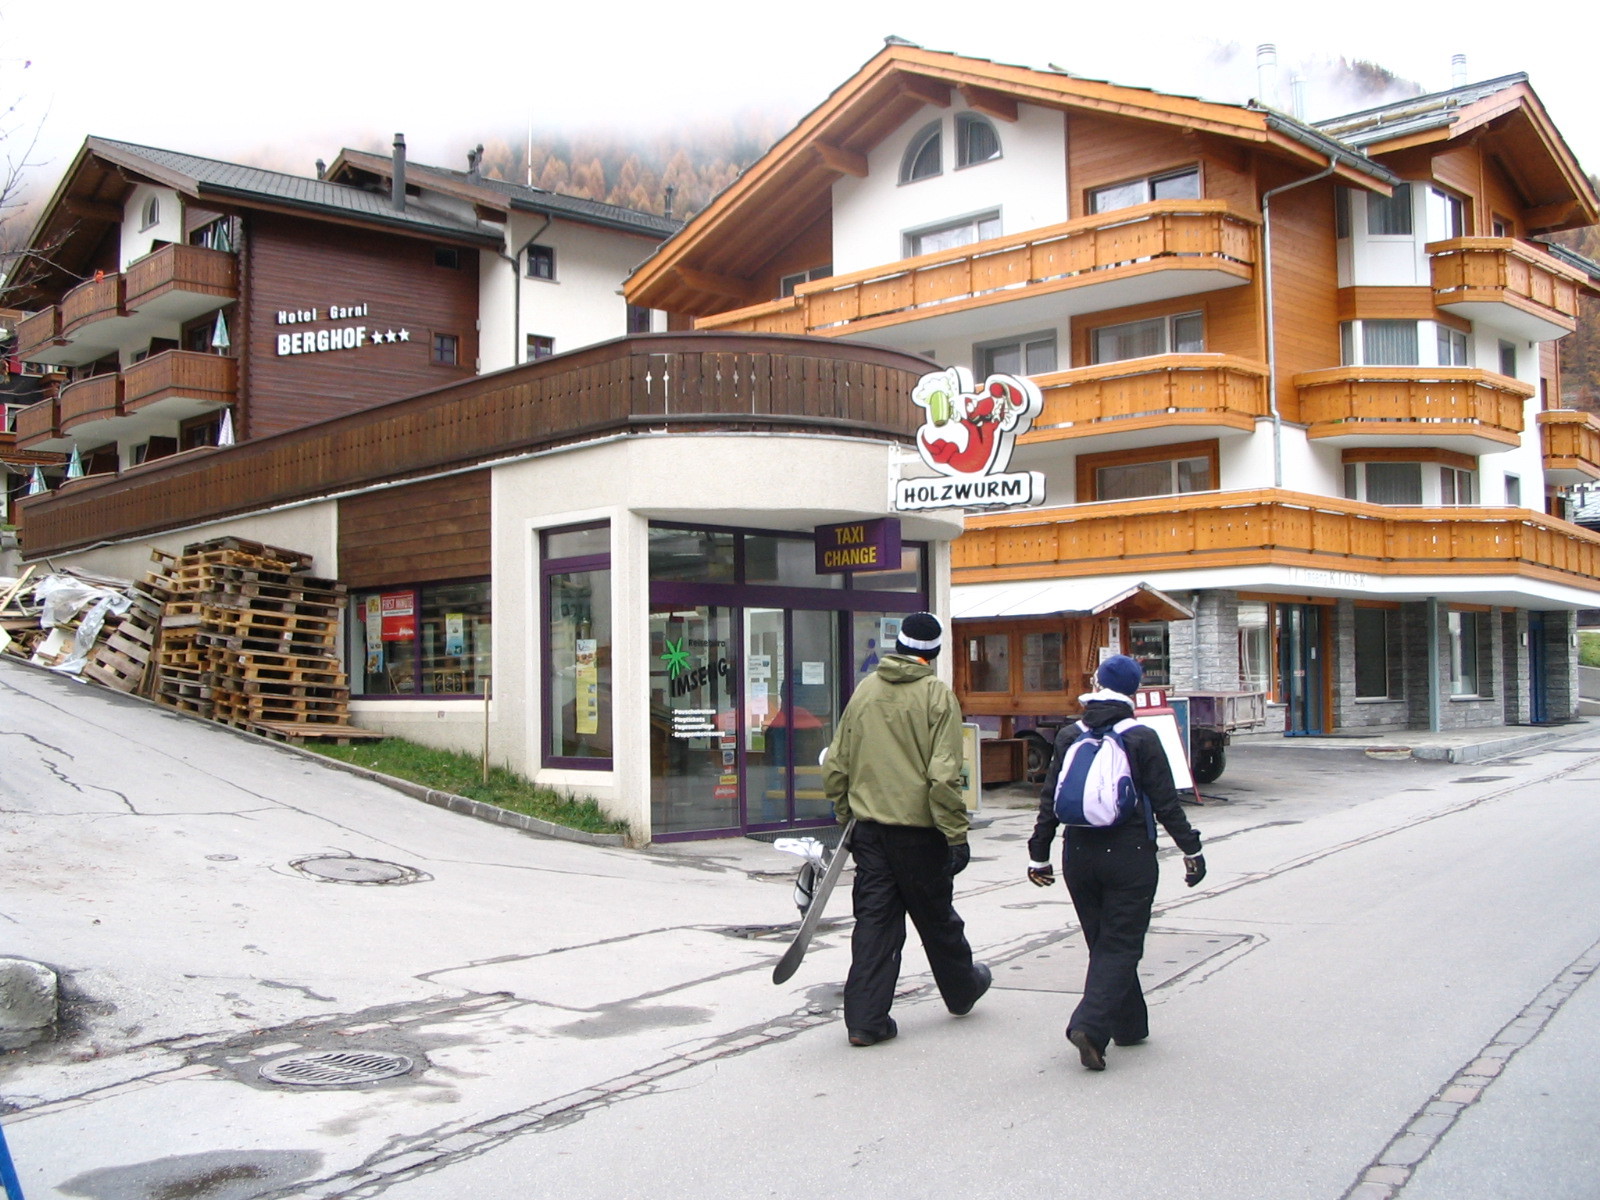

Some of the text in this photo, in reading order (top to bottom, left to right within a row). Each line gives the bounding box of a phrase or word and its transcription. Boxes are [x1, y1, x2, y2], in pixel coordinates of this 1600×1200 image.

[278, 302, 368, 324] Hotel Garni
[277, 326, 366, 356] BERGHOF
[904, 479, 1022, 503] HOLZWURM
[834, 526, 865, 545] TAXI
[824, 546, 877, 568] CHANGE
